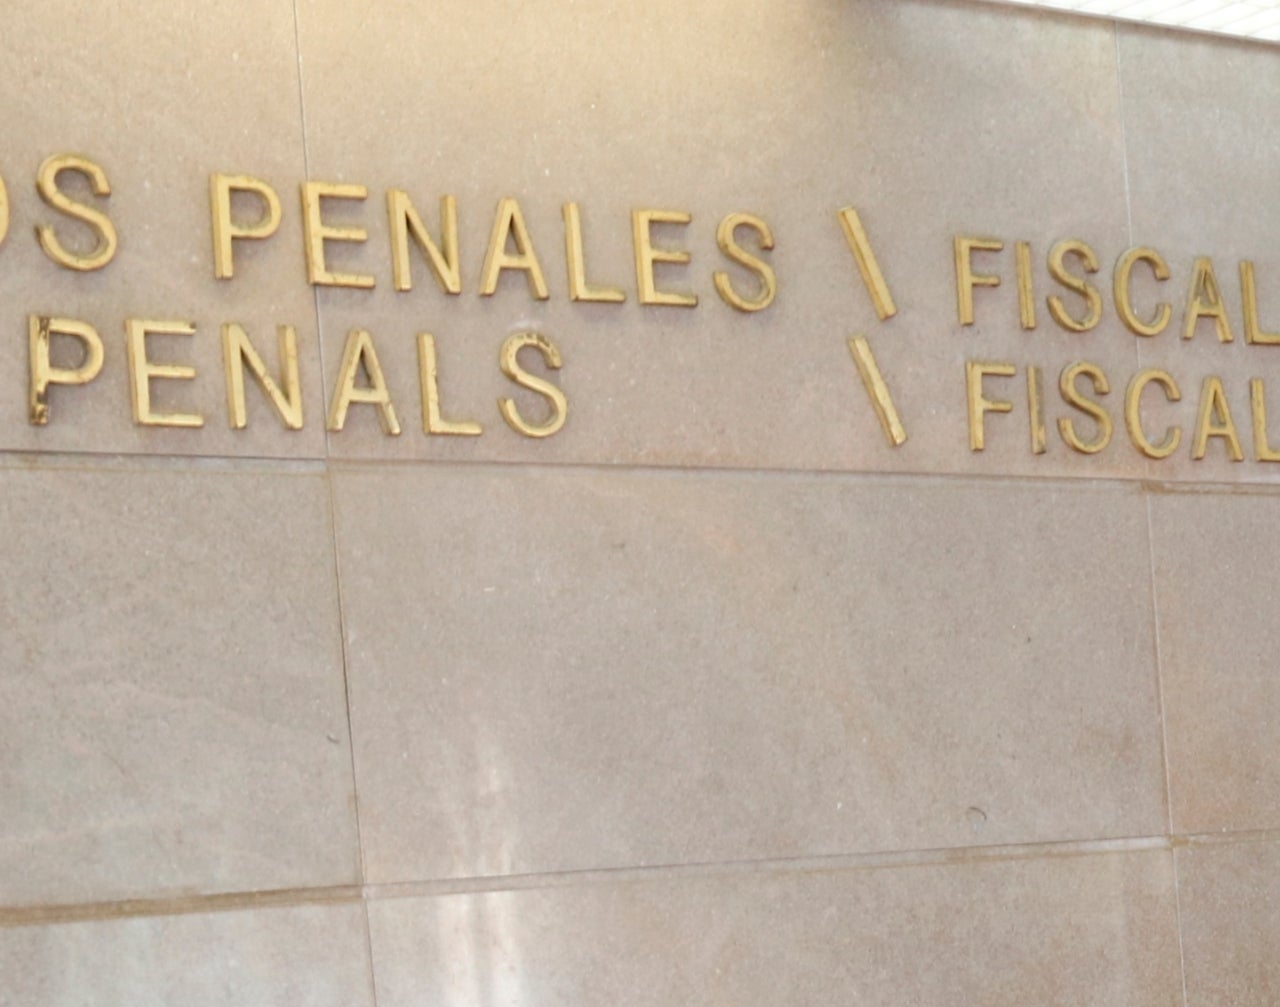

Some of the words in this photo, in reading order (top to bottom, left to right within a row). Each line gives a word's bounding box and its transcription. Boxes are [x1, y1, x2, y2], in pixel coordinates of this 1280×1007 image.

[0, 153, 118, 271] S
[209, 172, 777, 312] PENALES
[28, 314, 568, 438] PENALS
